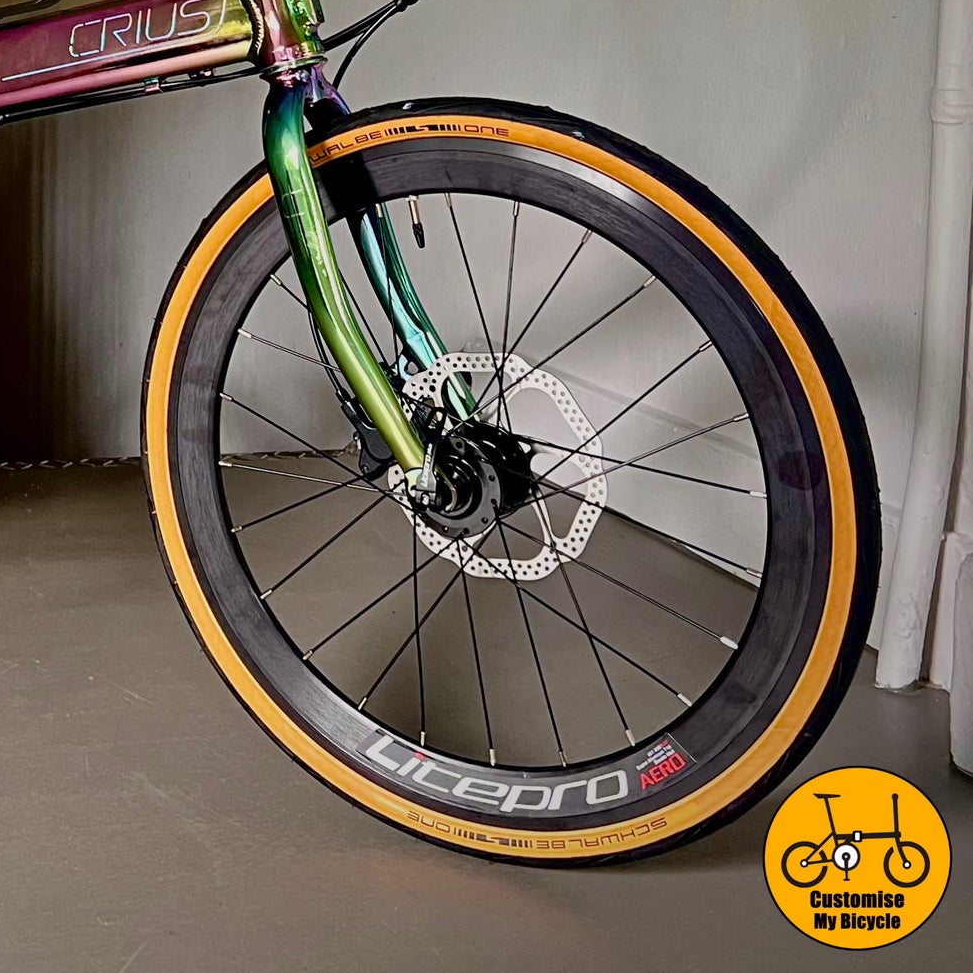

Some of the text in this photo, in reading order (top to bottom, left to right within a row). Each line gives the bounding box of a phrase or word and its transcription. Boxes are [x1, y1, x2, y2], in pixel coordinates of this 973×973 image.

[310, 124, 510, 163] WALBE ONE
[640, 752, 687, 790] AERO
[407, 810, 668, 850] SCHWALBE ONE
